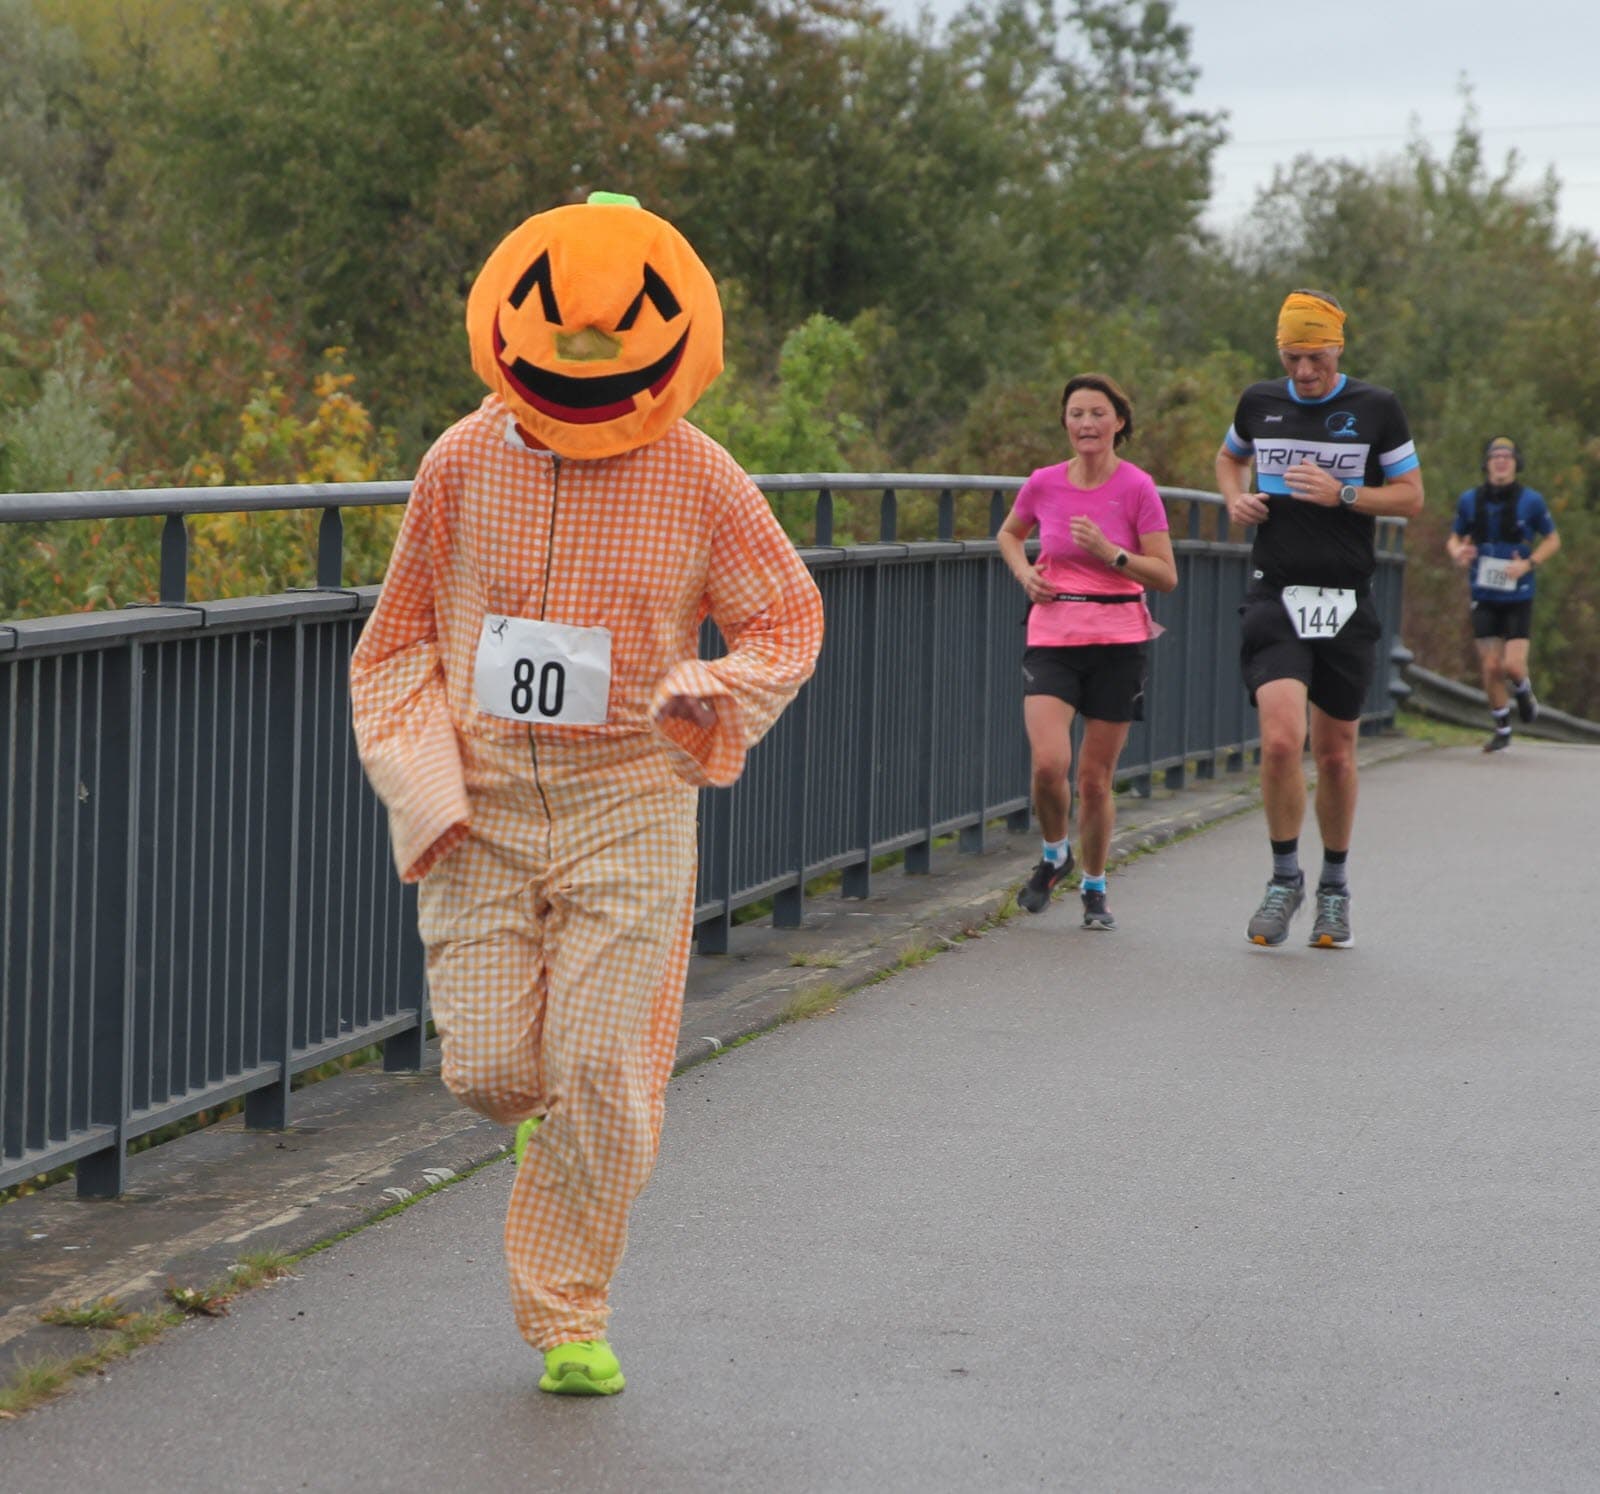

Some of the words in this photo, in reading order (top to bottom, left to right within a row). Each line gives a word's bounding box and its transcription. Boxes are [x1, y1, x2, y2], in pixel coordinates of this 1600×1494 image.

[1258, 448, 1361, 470] TRITYC
[1298, 606, 1340, 634] 144
[511, 657, 565, 717] 80
